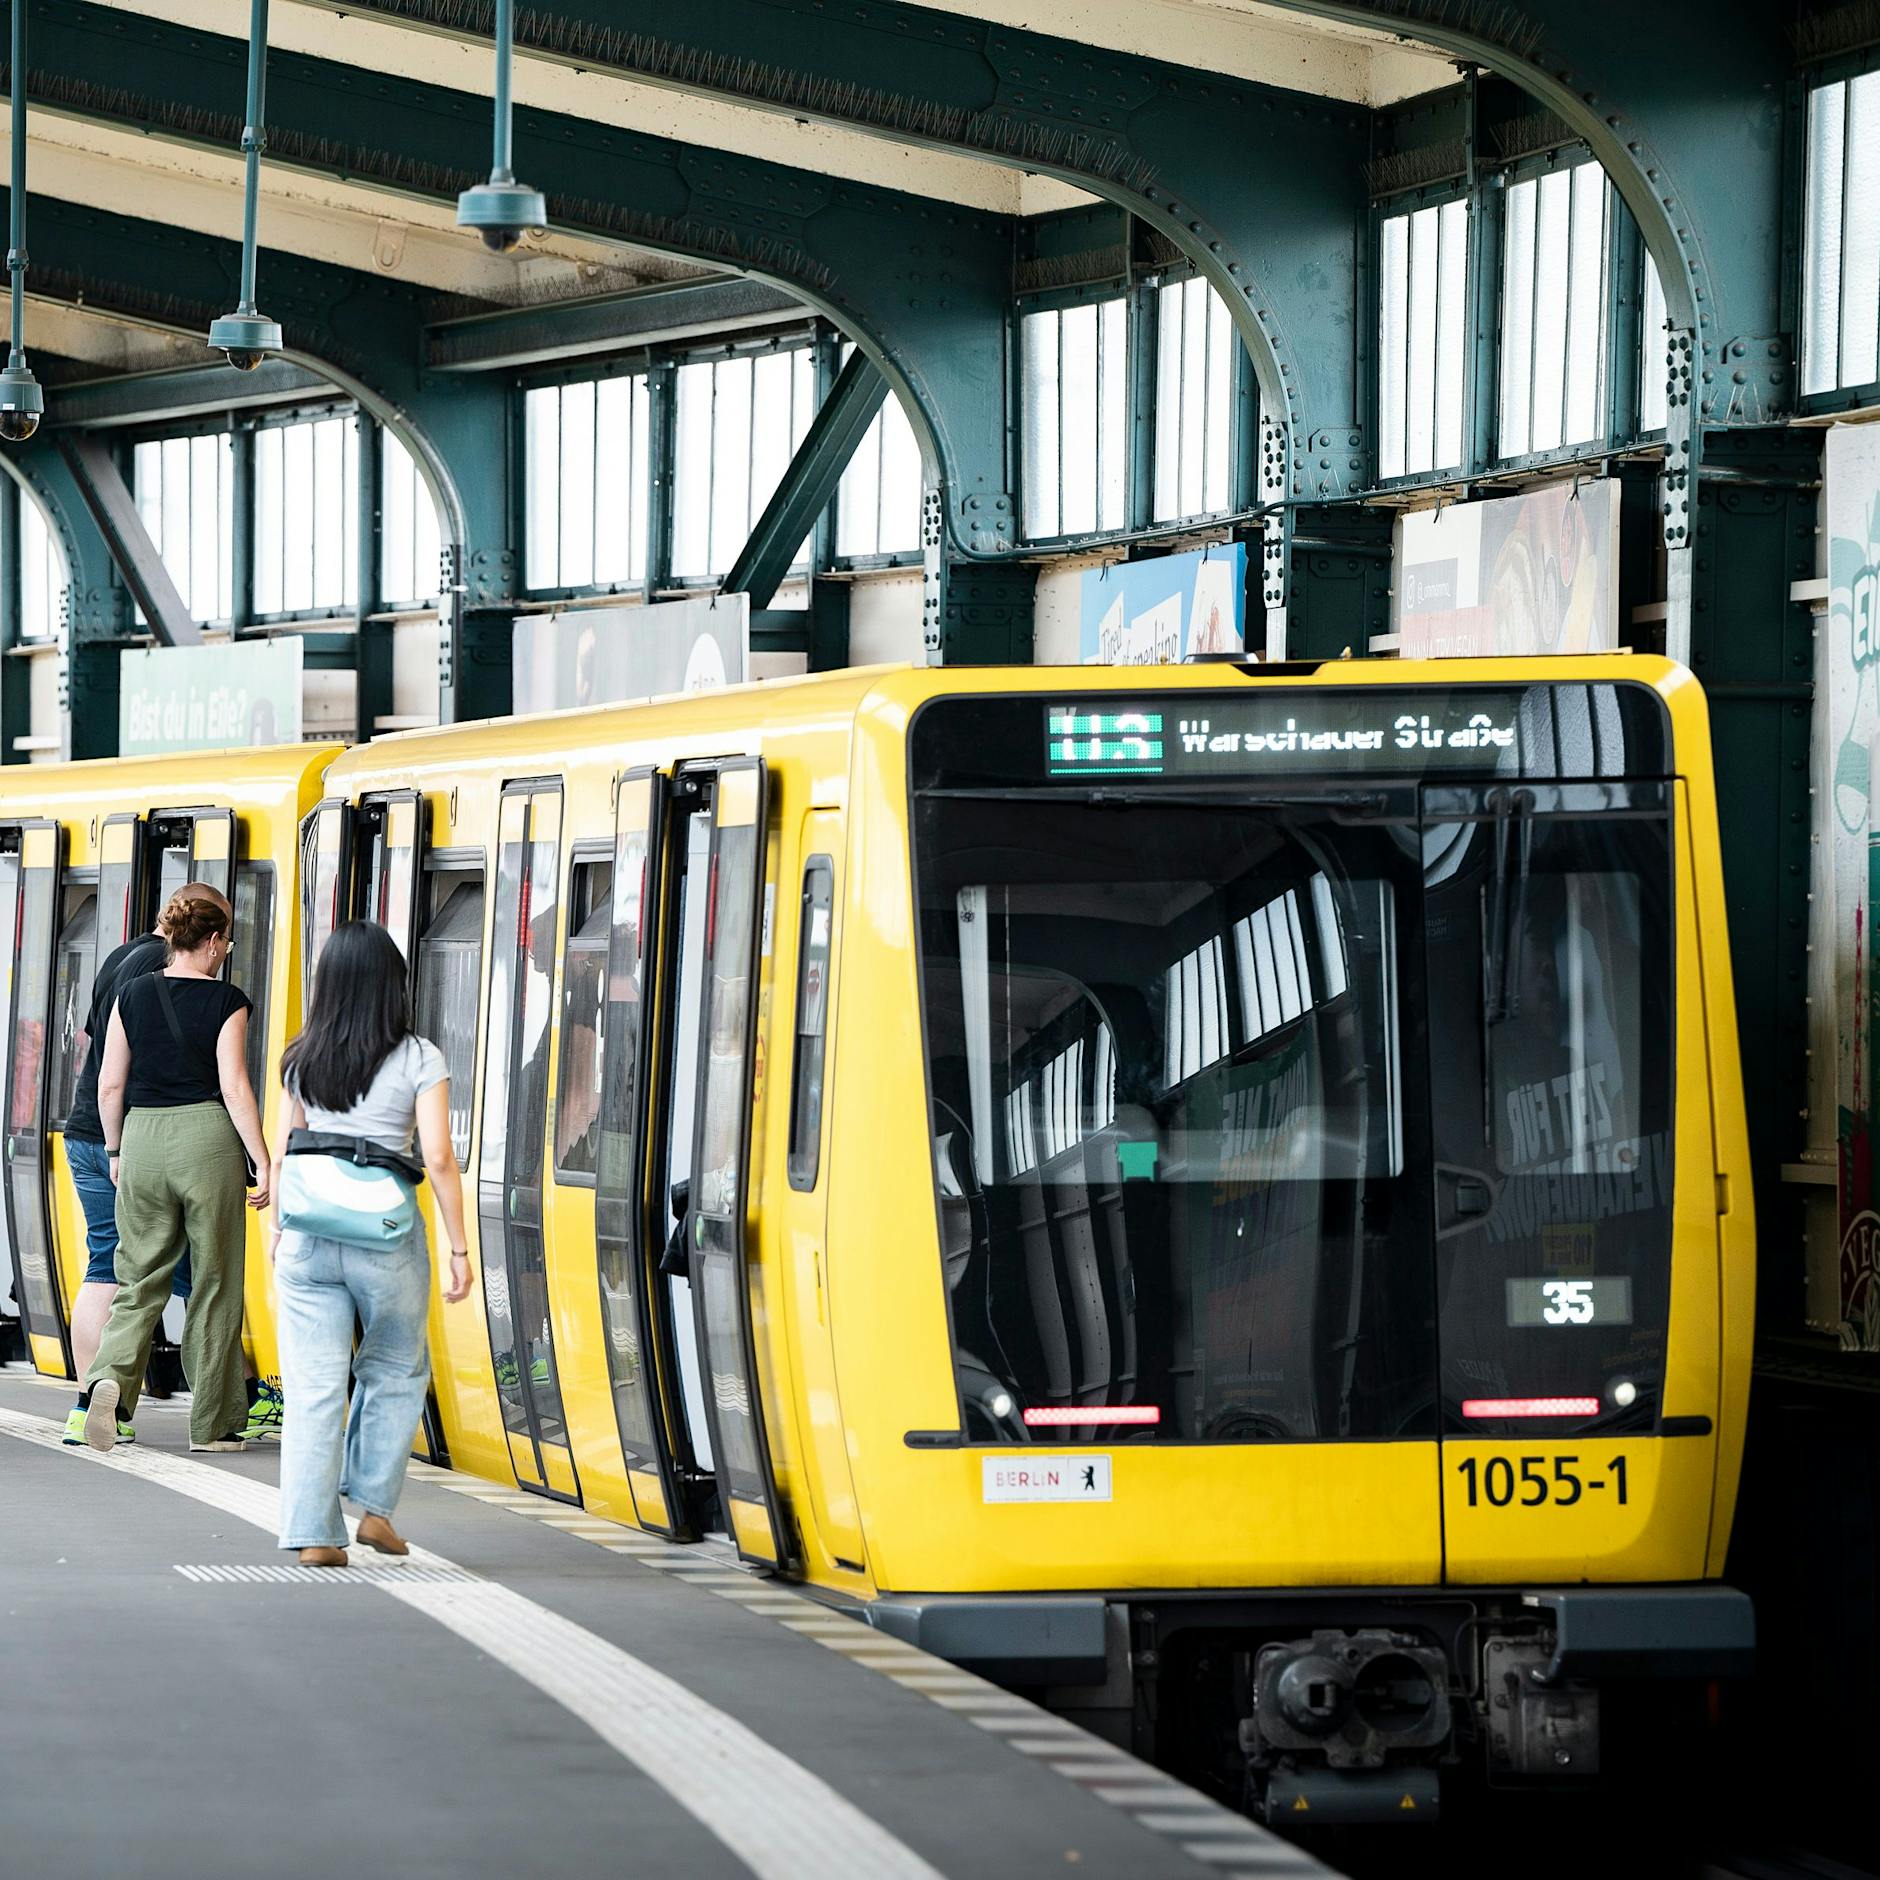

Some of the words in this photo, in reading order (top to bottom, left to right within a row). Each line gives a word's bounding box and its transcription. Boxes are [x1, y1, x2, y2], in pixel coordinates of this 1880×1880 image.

[1102, 607, 1122, 662] Tired
[128, 687, 160, 742] Bist
[163, 690, 186, 740] du
[187, 685, 205, 740] in
[208, 684, 248, 739] Eile?
[1179, 717, 1384, 754] Warschauer
[1394, 713, 1516, 749] Straße
[1542, 1280, 1595, 1325] 35
[996, 1471, 1060, 1487] BERLIN
[1457, 1454, 1630, 1508] 1055-1
